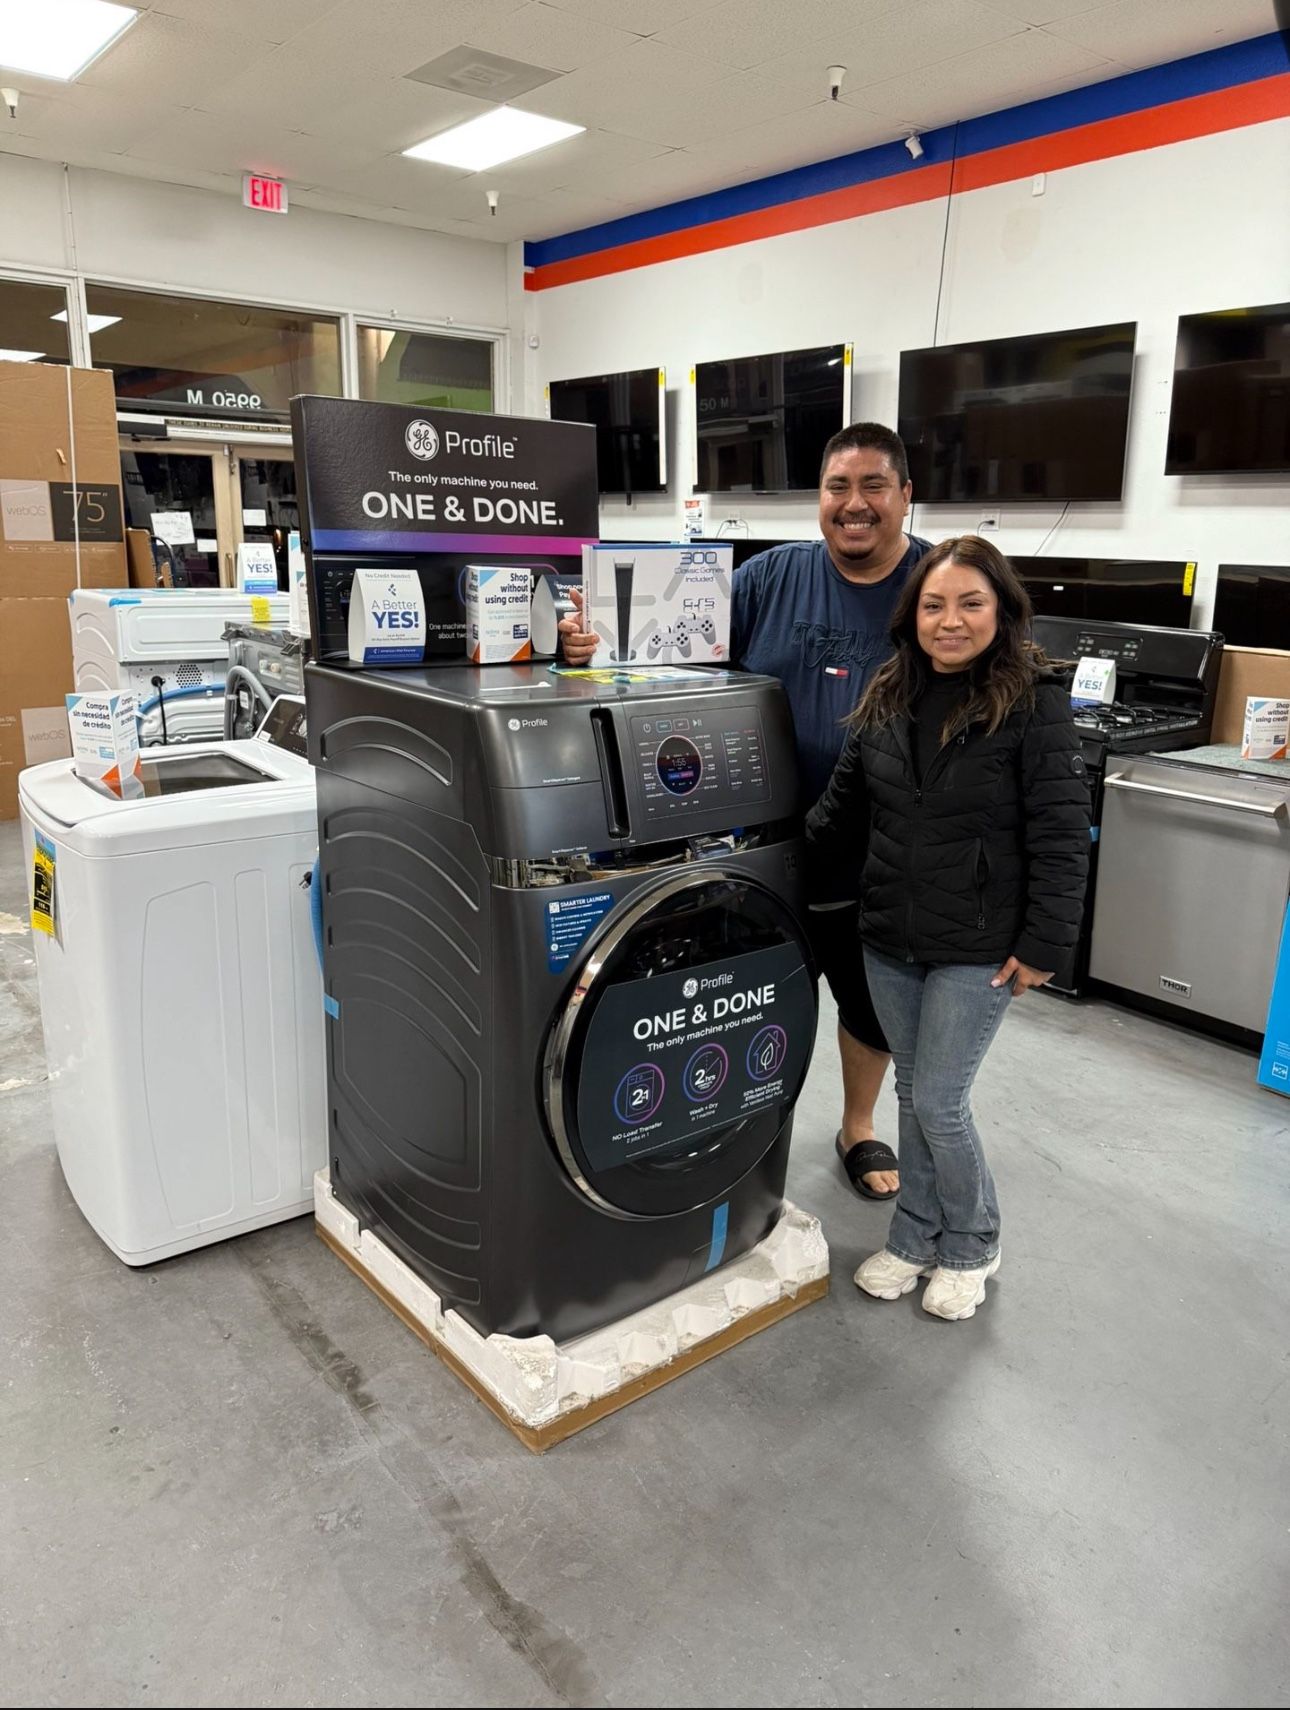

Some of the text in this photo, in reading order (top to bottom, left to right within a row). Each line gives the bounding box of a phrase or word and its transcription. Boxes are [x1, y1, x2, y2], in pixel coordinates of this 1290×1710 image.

[251, 178, 282, 210] EXIT
[388, 471, 539, 490] The only machine you need.
[6, 505, 47, 516] webOS
[362, 491, 564, 525] ONE & DONE.
[680, 551, 717, 565] 300
[247, 563, 273, 574] YES!
[510, 573, 529, 583] Shop
[500, 585, 529, 593] without
[371, 600, 417, 610] A Better
[485, 595, 529, 606] using credit
[371, 611, 419, 629] YES!
[1077, 679, 1103, 691] YES!
[86, 702, 109, 711] Compra
[81, 711, 110, 720] necesidad
[521, 718, 548, 728] Profile
[560, 898, 587, 908] SMARTER
[587, 894, 611, 904] LAUNDRY
[1161, 978, 1188, 993] THOR
[633, 983, 775, 1040] ONE & DONE
[646, 1010, 764, 1053] The only machine you need.
[689, 1106, 705, 1116] Wash
[708, 1102, 719, 1110] Dry
[612, 1121, 663, 1142] NO Load Transfer
